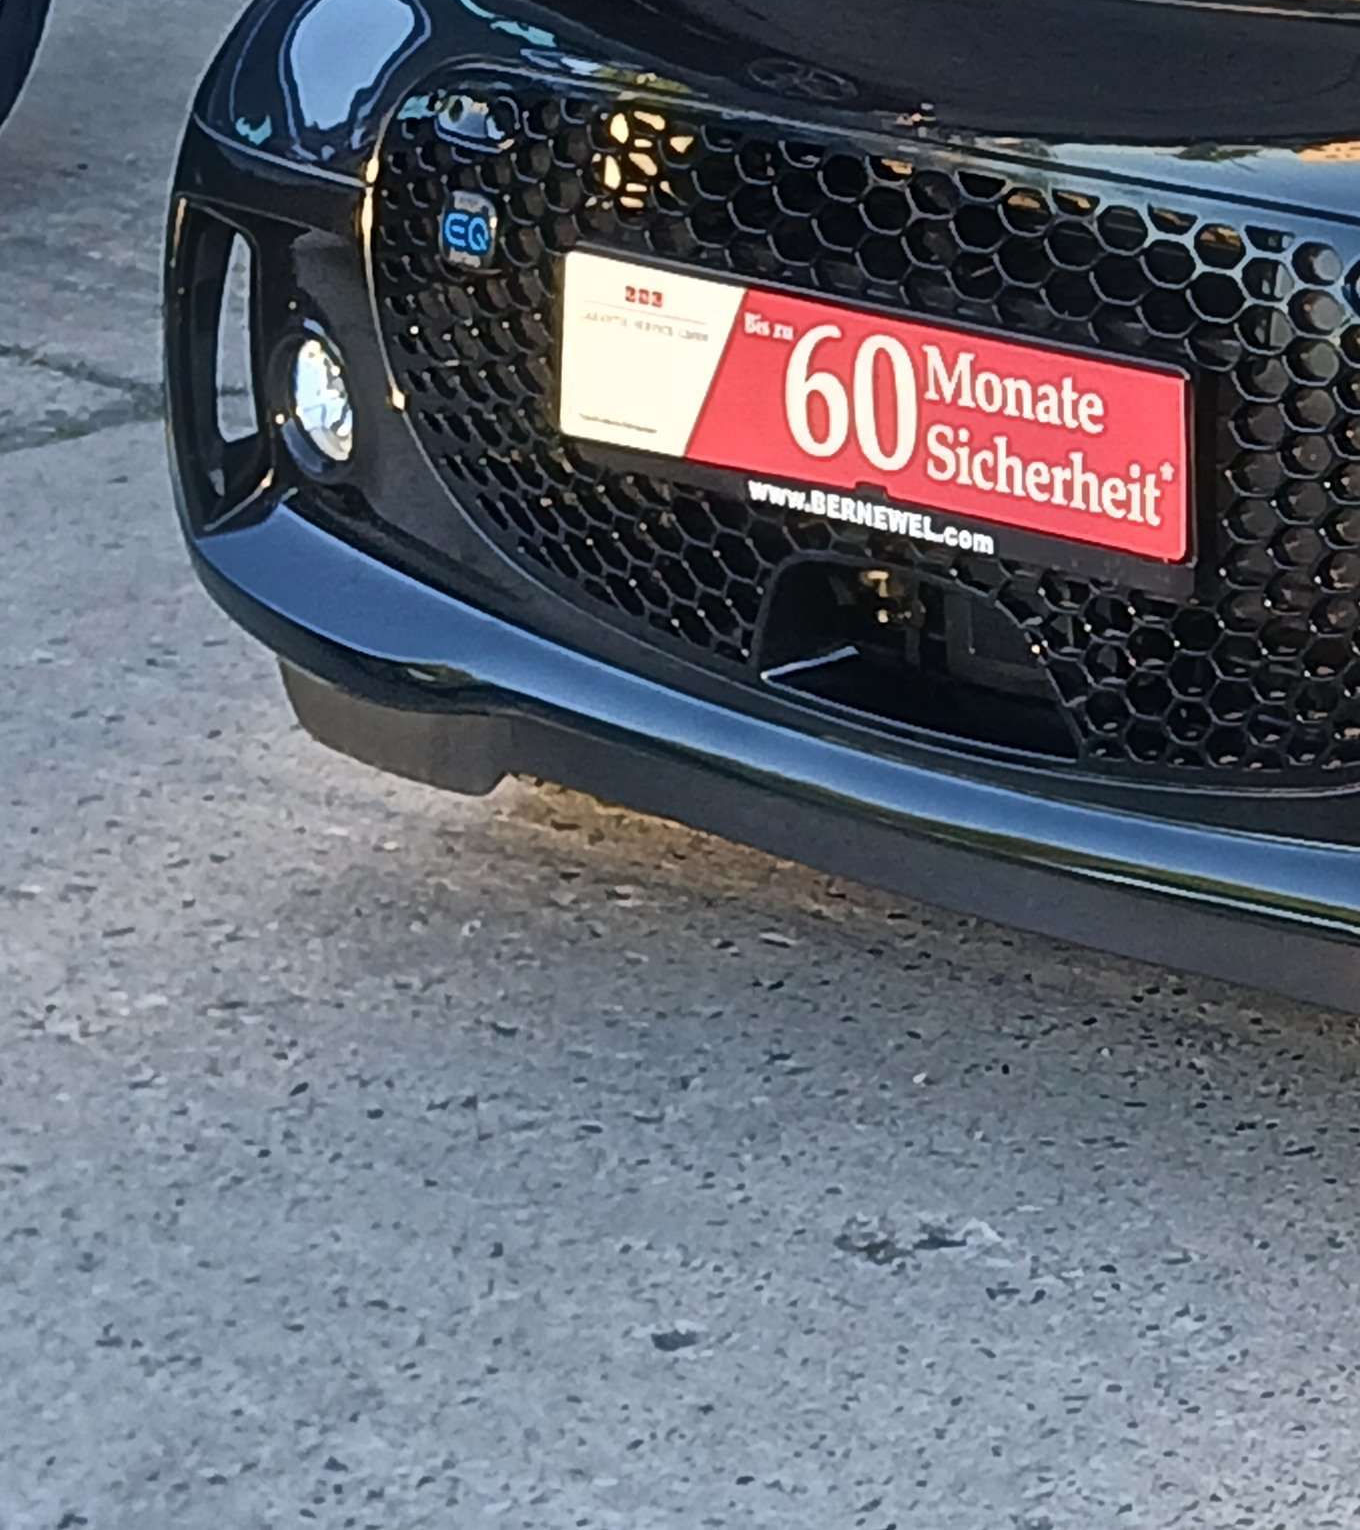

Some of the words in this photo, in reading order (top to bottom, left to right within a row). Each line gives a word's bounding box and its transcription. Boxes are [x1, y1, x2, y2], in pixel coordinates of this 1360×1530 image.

[444, 212, 490, 251] EQ
[784, 324, 919, 472] 60
[922, 345, 1104, 435] Monate
